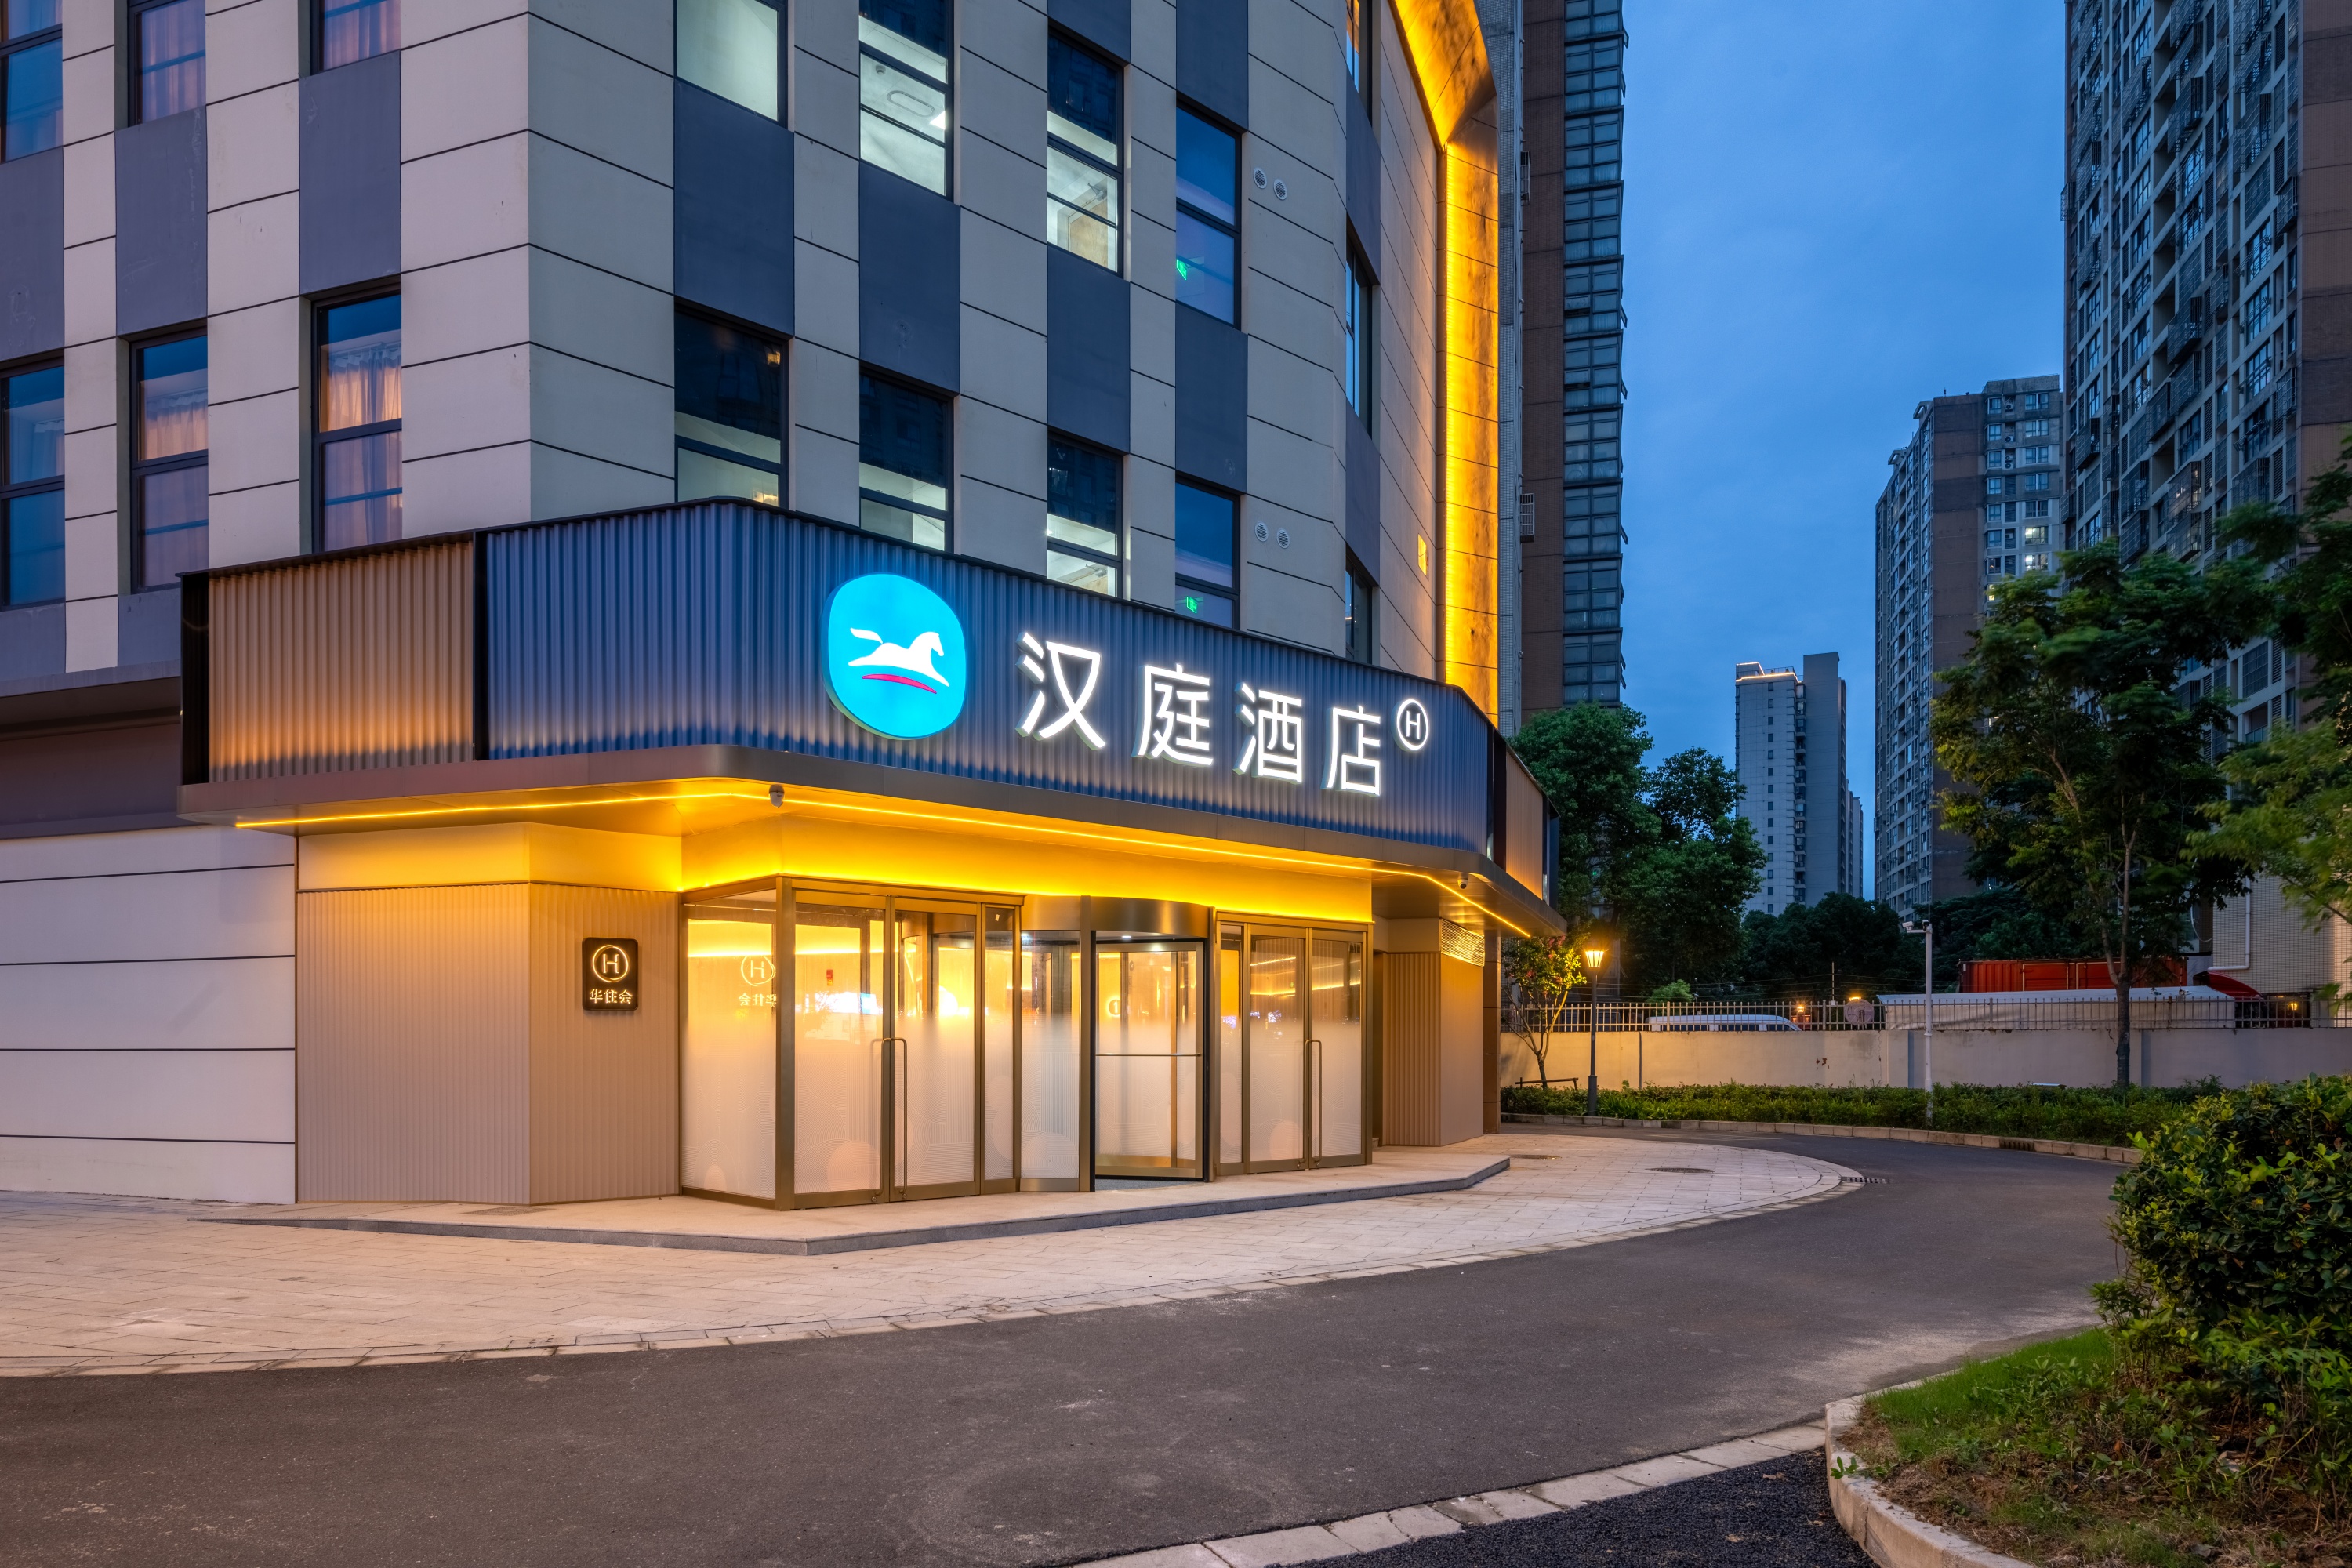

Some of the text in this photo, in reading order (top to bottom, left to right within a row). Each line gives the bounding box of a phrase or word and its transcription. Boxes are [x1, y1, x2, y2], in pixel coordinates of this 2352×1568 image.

[1018, 631, 1382, 797] 汉庭酒店
[590, 989, 633, 1004] 华住会
